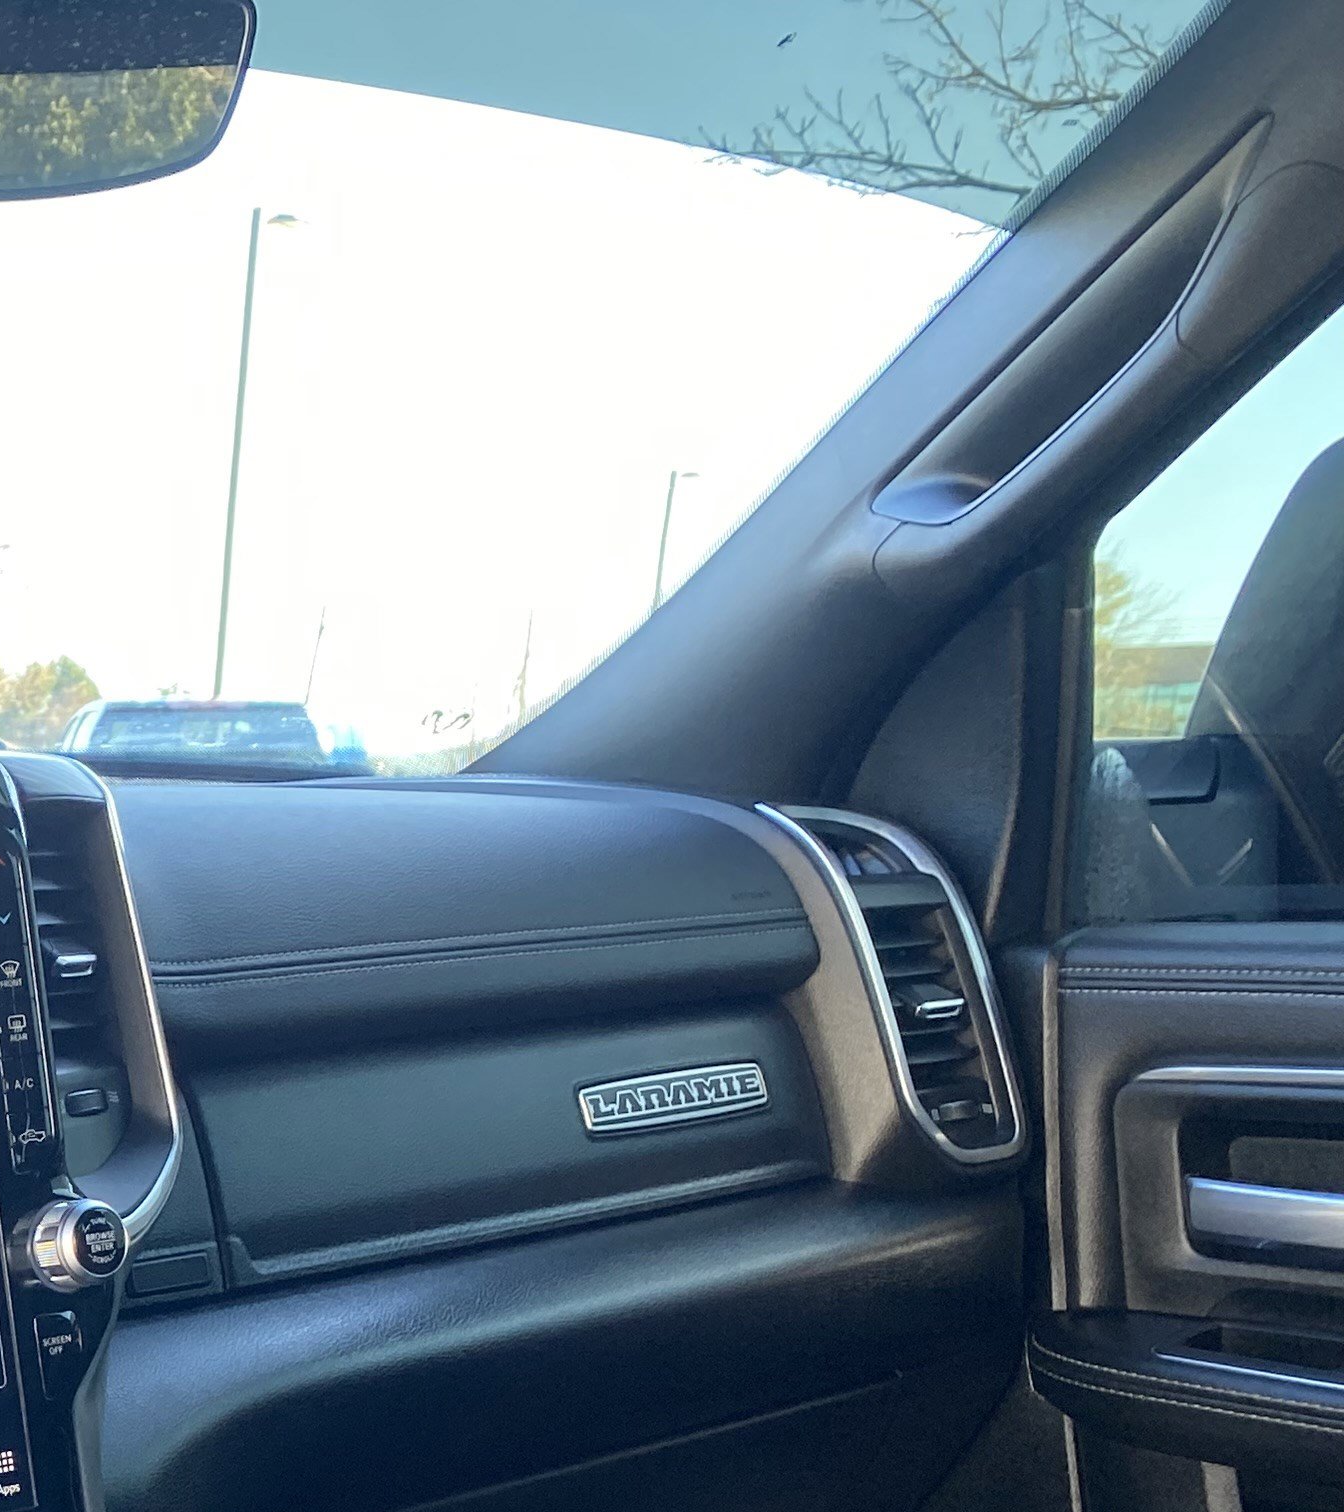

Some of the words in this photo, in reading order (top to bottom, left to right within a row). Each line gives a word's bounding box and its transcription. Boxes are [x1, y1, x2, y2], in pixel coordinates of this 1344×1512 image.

[14, 1077, 34, 1090] A/C
[586, 1071, 763, 1121] LARAMIE
[85, 1230, 116, 1244] BROWSE
[90, 1242, 115, 1254] ENTER
[42, 1334, 72, 1348] SCREEN
[48, 1345, 63, 1356] OFF
